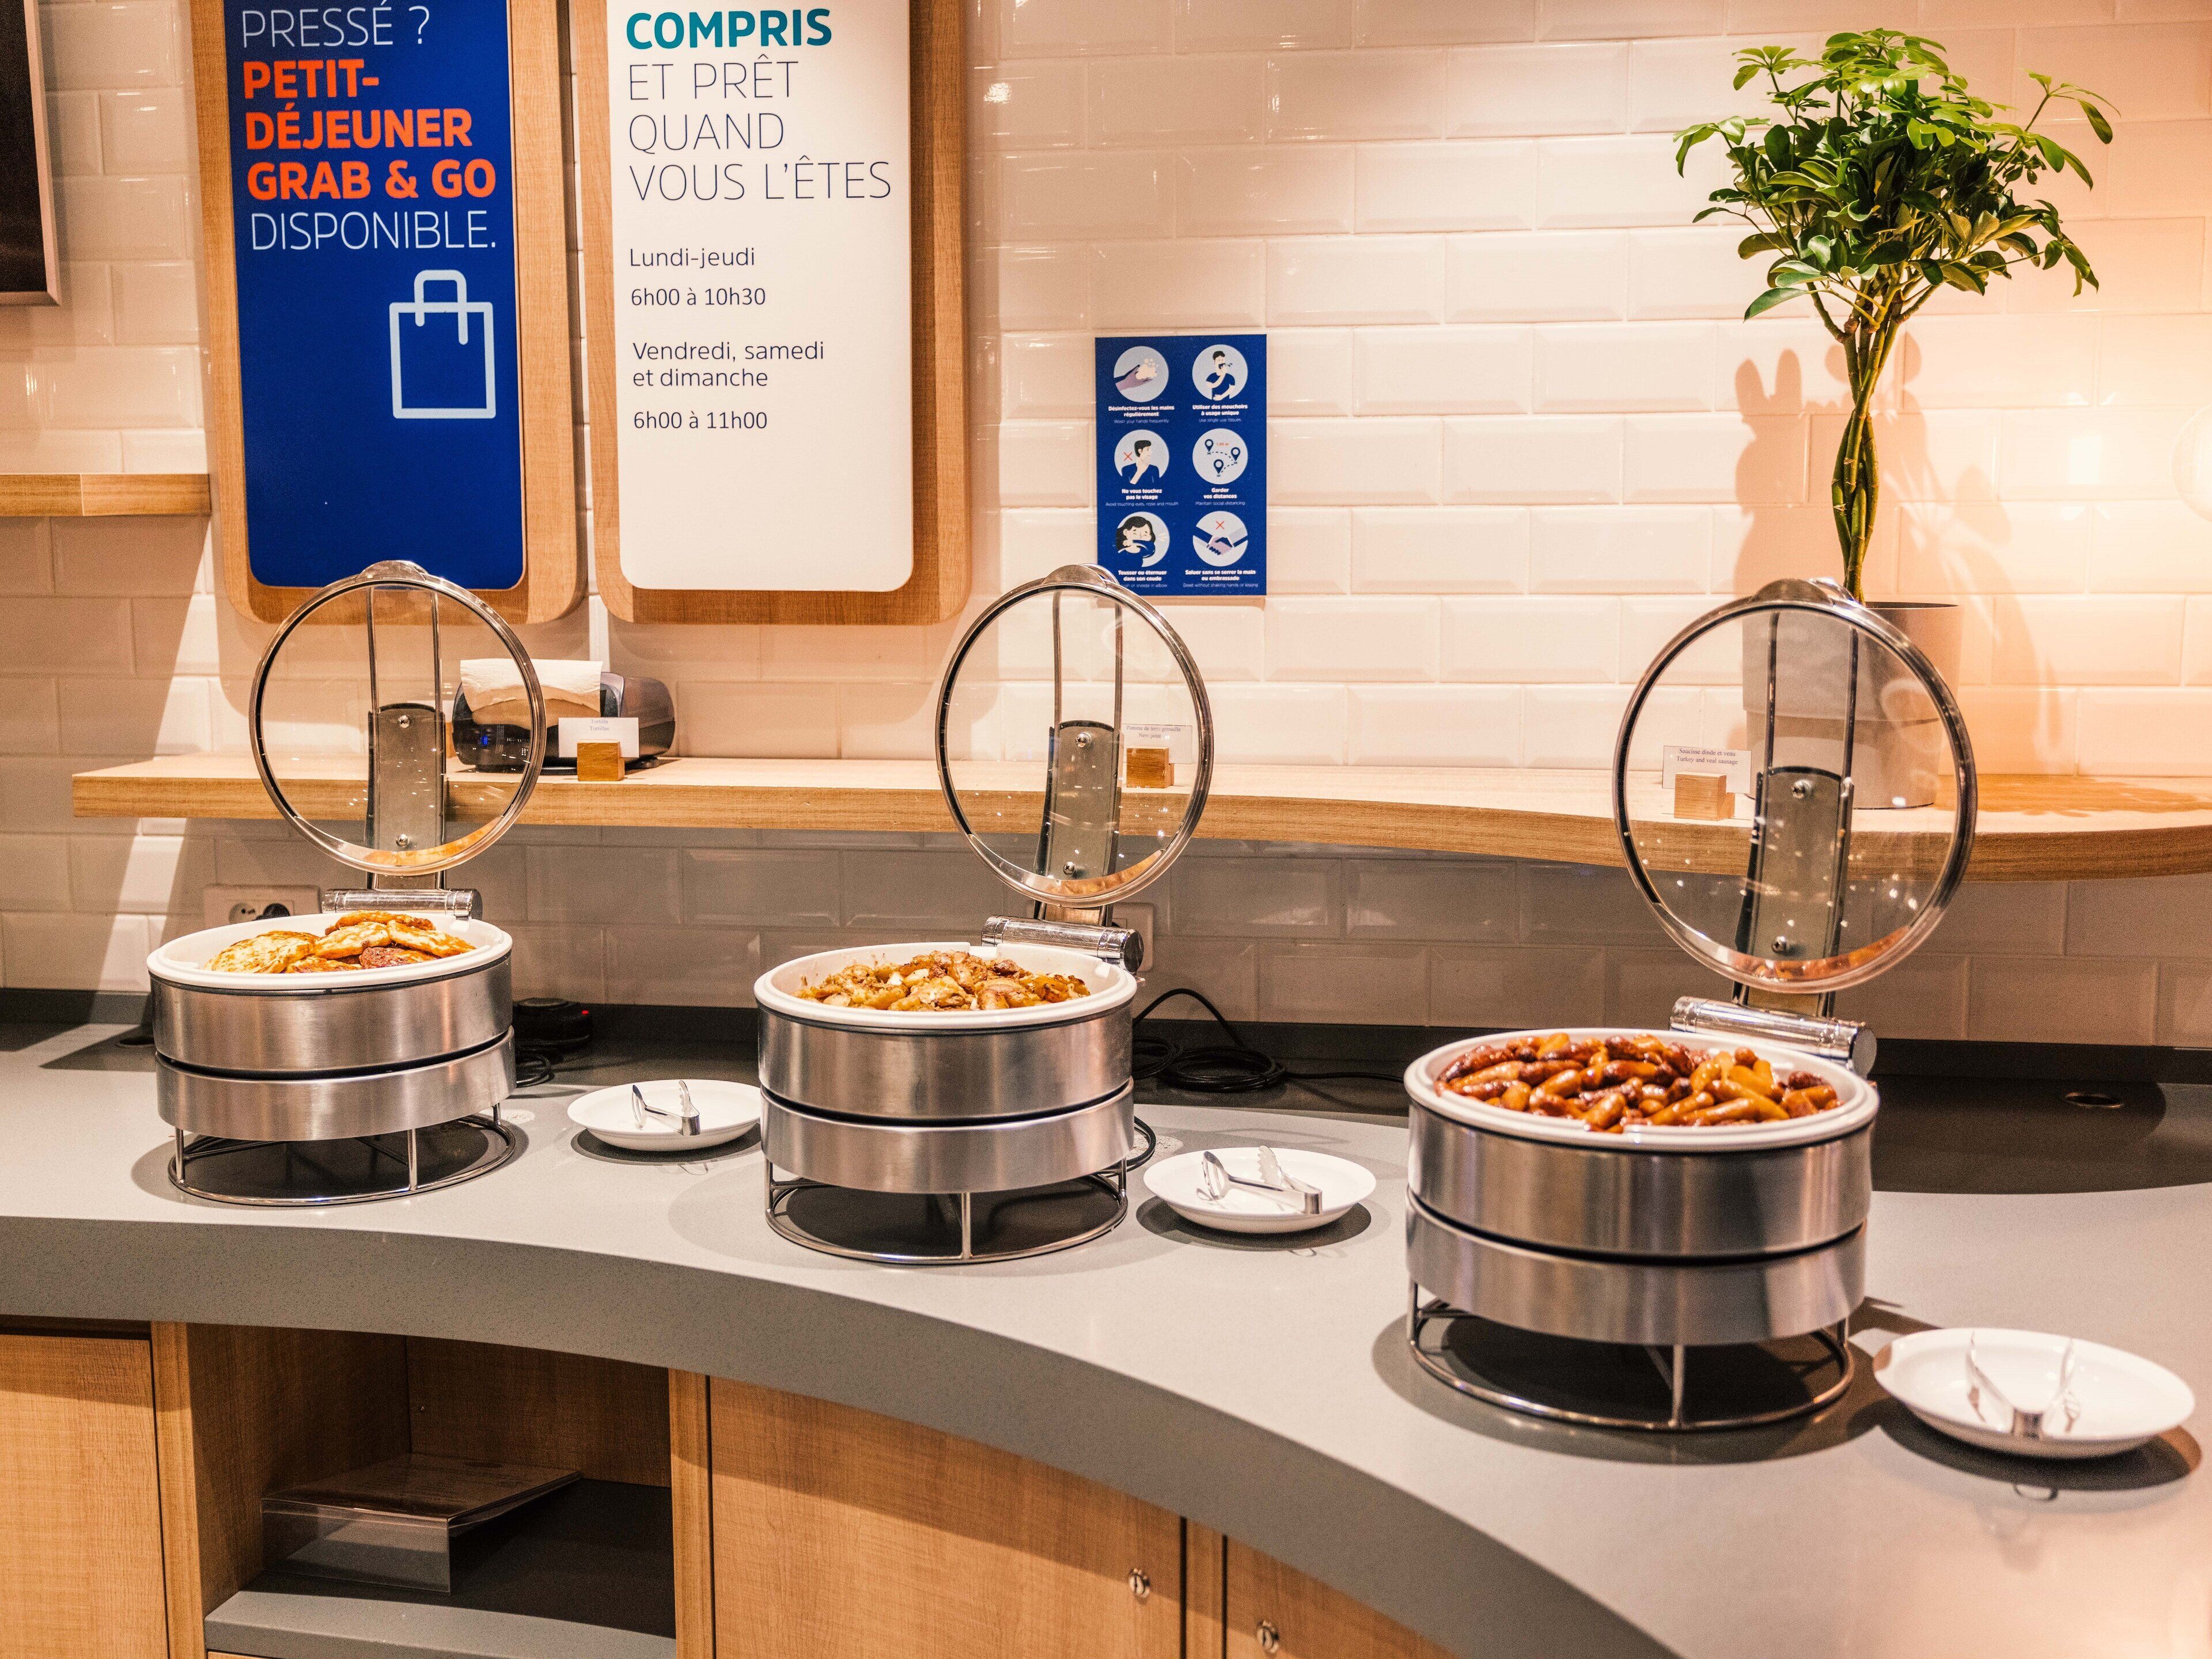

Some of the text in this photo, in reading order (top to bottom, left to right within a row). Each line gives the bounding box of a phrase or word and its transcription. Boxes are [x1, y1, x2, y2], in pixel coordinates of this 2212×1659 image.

[243, 0, 430, 48] PRESSÉ ?
[626, 9, 832, 50] COMPRIS
[243, 59, 380, 99] PETIT-
[630, 54, 798, 100] ET PRÊT
[245, 103, 472, 149] DÉJEUNER
[630, 113, 783, 154] QUAND
[247, 158, 496, 200] GRAB & GO
[630, 164, 745, 200] VOUS
[251, 210, 495, 250] DISPONIBLE.
[630, 248, 755, 268] Lundi-jeudi
[631, 287, 766, 306] 6h00 à 10h30
[632, 341, 824, 362] Vendredi, samedi
[632, 369, 768, 387] et dimanche
[634, 411, 767, 429] 6h00 à 11h00
